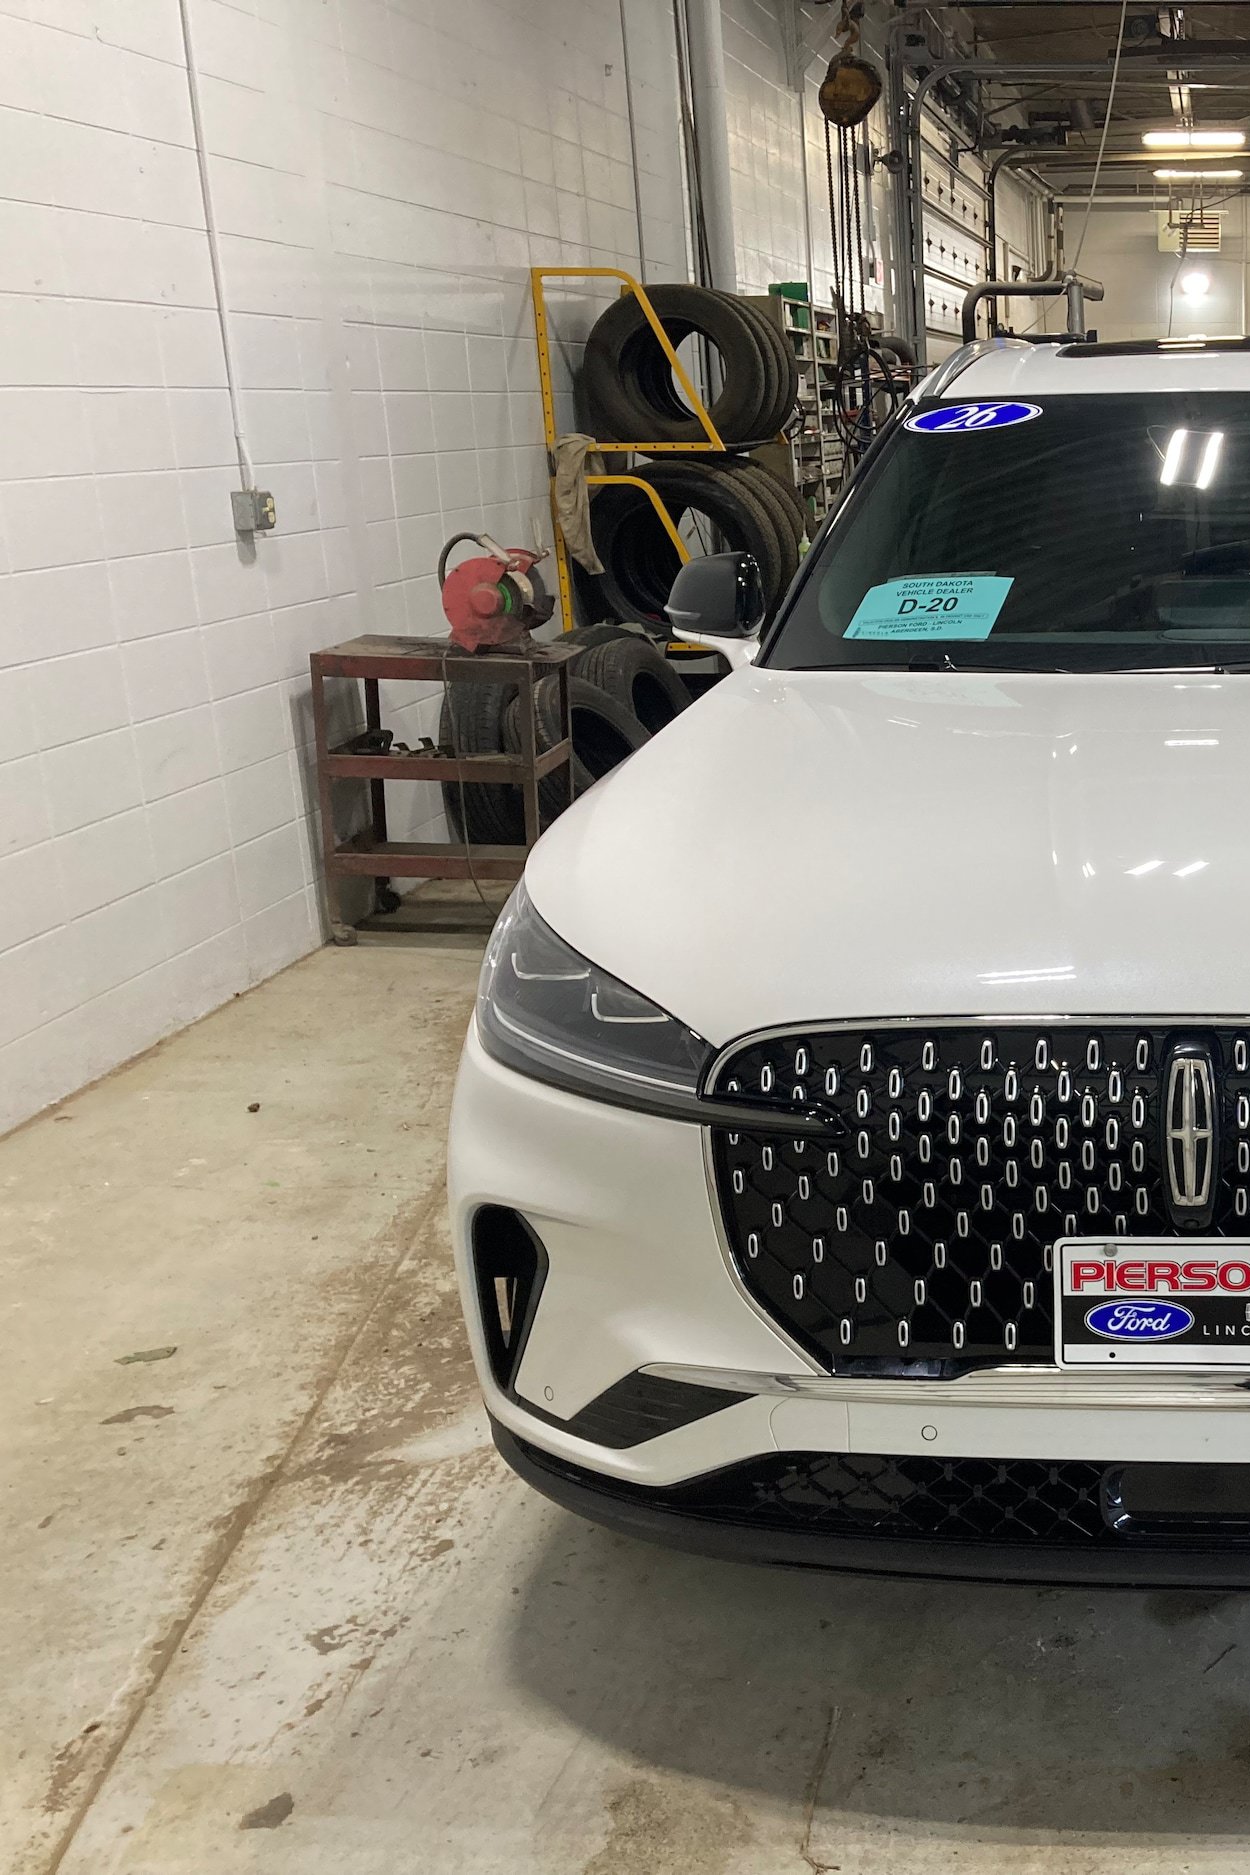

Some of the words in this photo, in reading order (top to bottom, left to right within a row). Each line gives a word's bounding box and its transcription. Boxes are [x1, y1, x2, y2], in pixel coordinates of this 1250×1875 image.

[934, 403, 1012, 430] 26
[896, 589, 935, 597] VEHICLE
[936, 587, 974, 595] DEALER
[902, 581, 934, 589] SOUTH
[935, 580, 973, 588] DAKOTA
[897, 597, 959, 615] D-20
[1107, 1305, 1171, 1332] Ford
